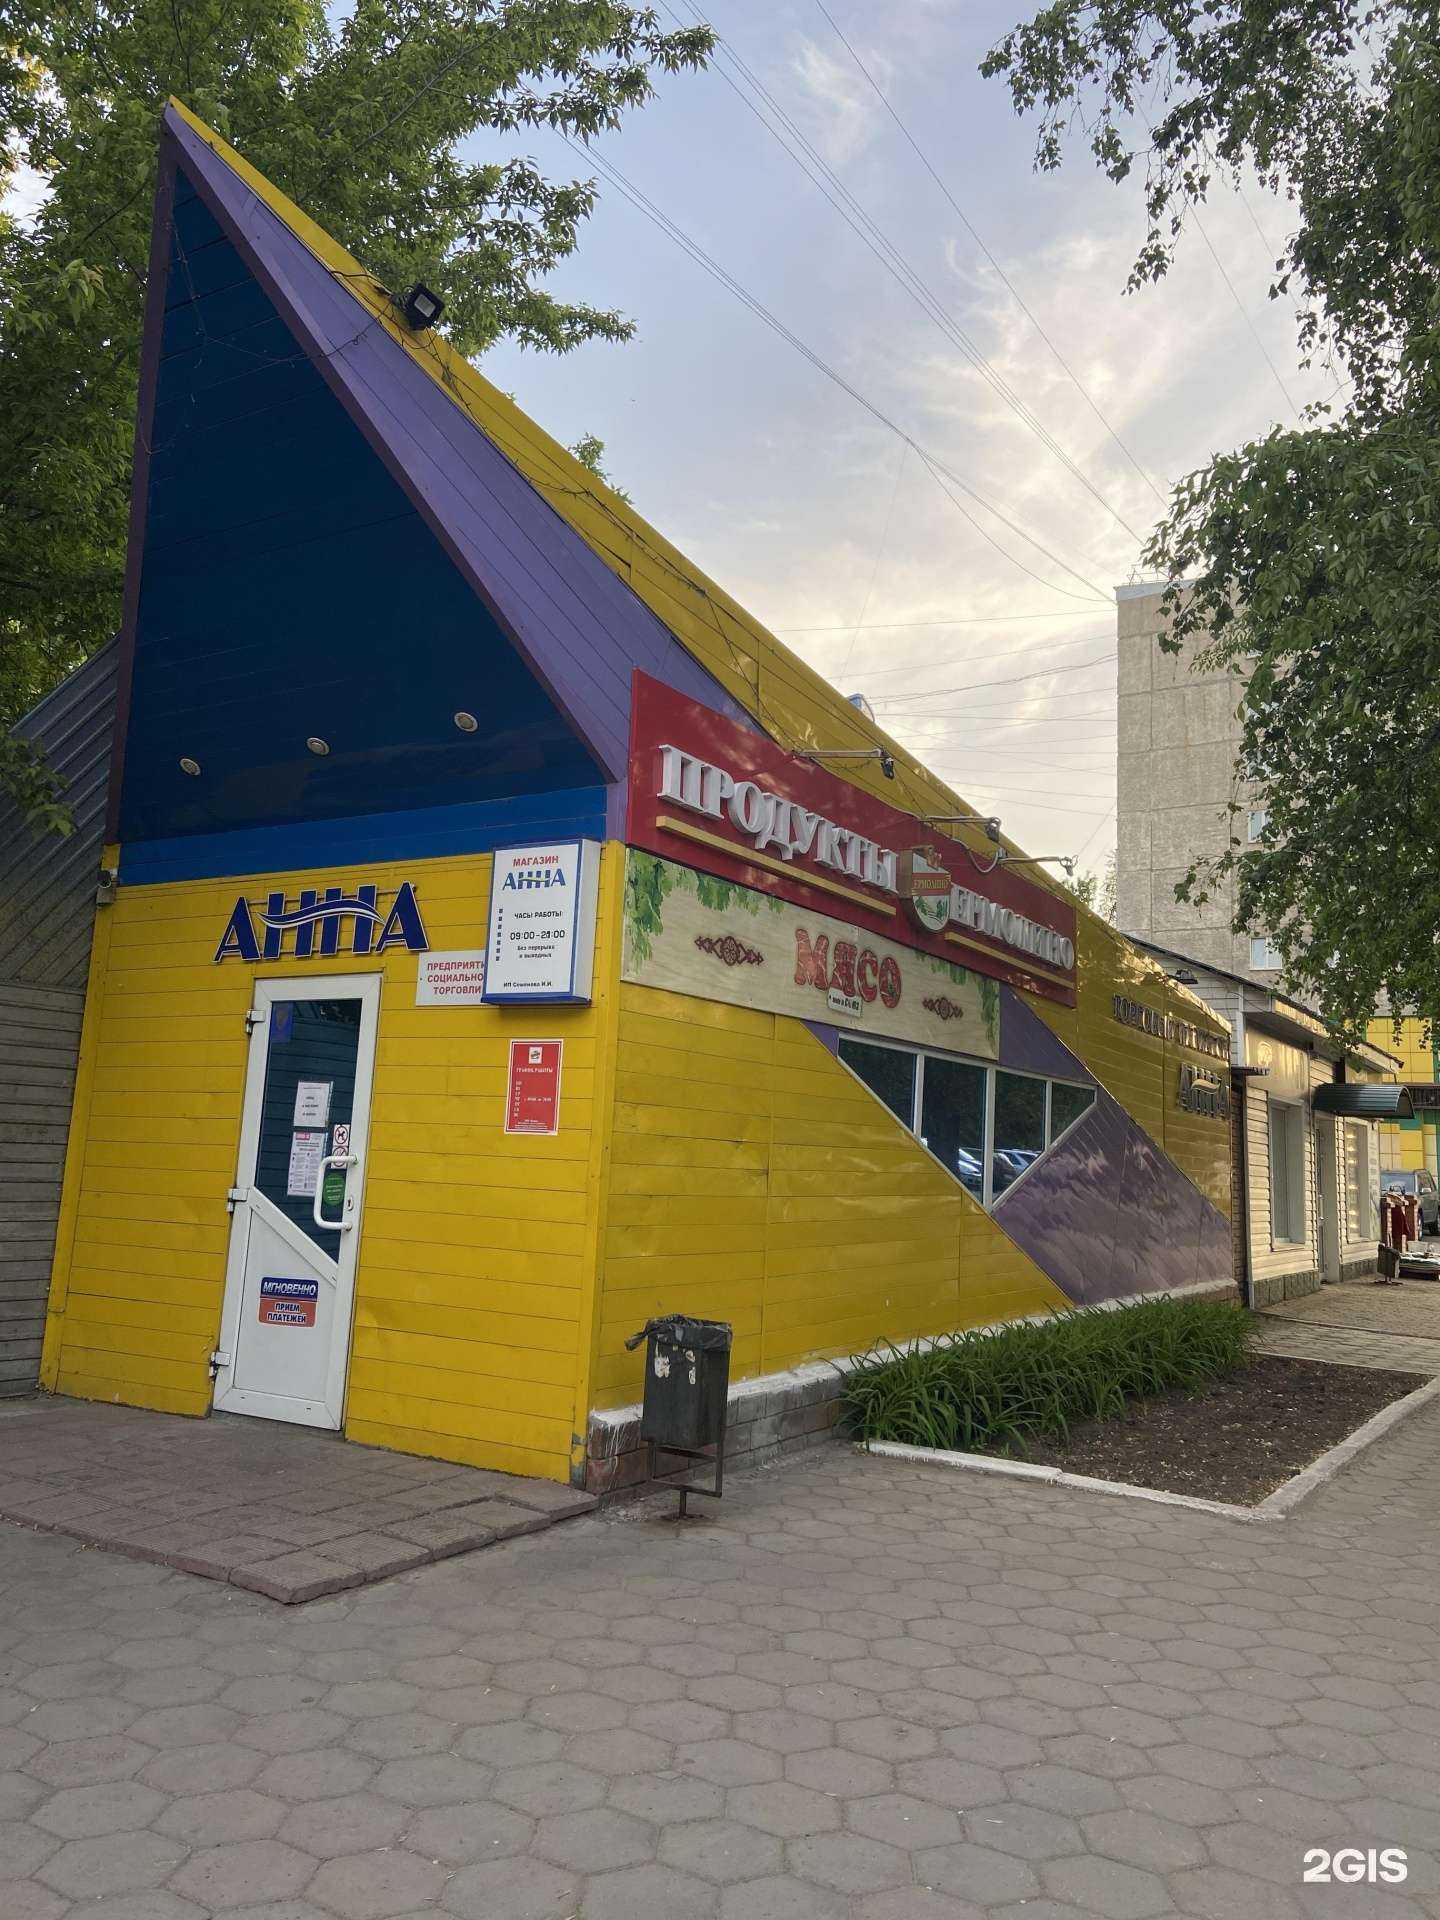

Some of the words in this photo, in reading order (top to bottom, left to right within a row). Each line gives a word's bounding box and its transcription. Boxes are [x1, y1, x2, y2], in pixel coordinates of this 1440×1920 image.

[657, 744, 898, 894] ПРОДУКТЫ
[513, 855, 559, 867] МАГАЗИН
[502, 868, 566, 890] АННА
[212, 881, 429, 963] АННА
[794, 928, 902, 1008] МЯСО
[433, 986, 481, 995] ТОРГОВЛИ
[263, 1281, 316, 1295] МГНОВЕННО
[275, 1303, 300, 1312] ПРИЕМ
